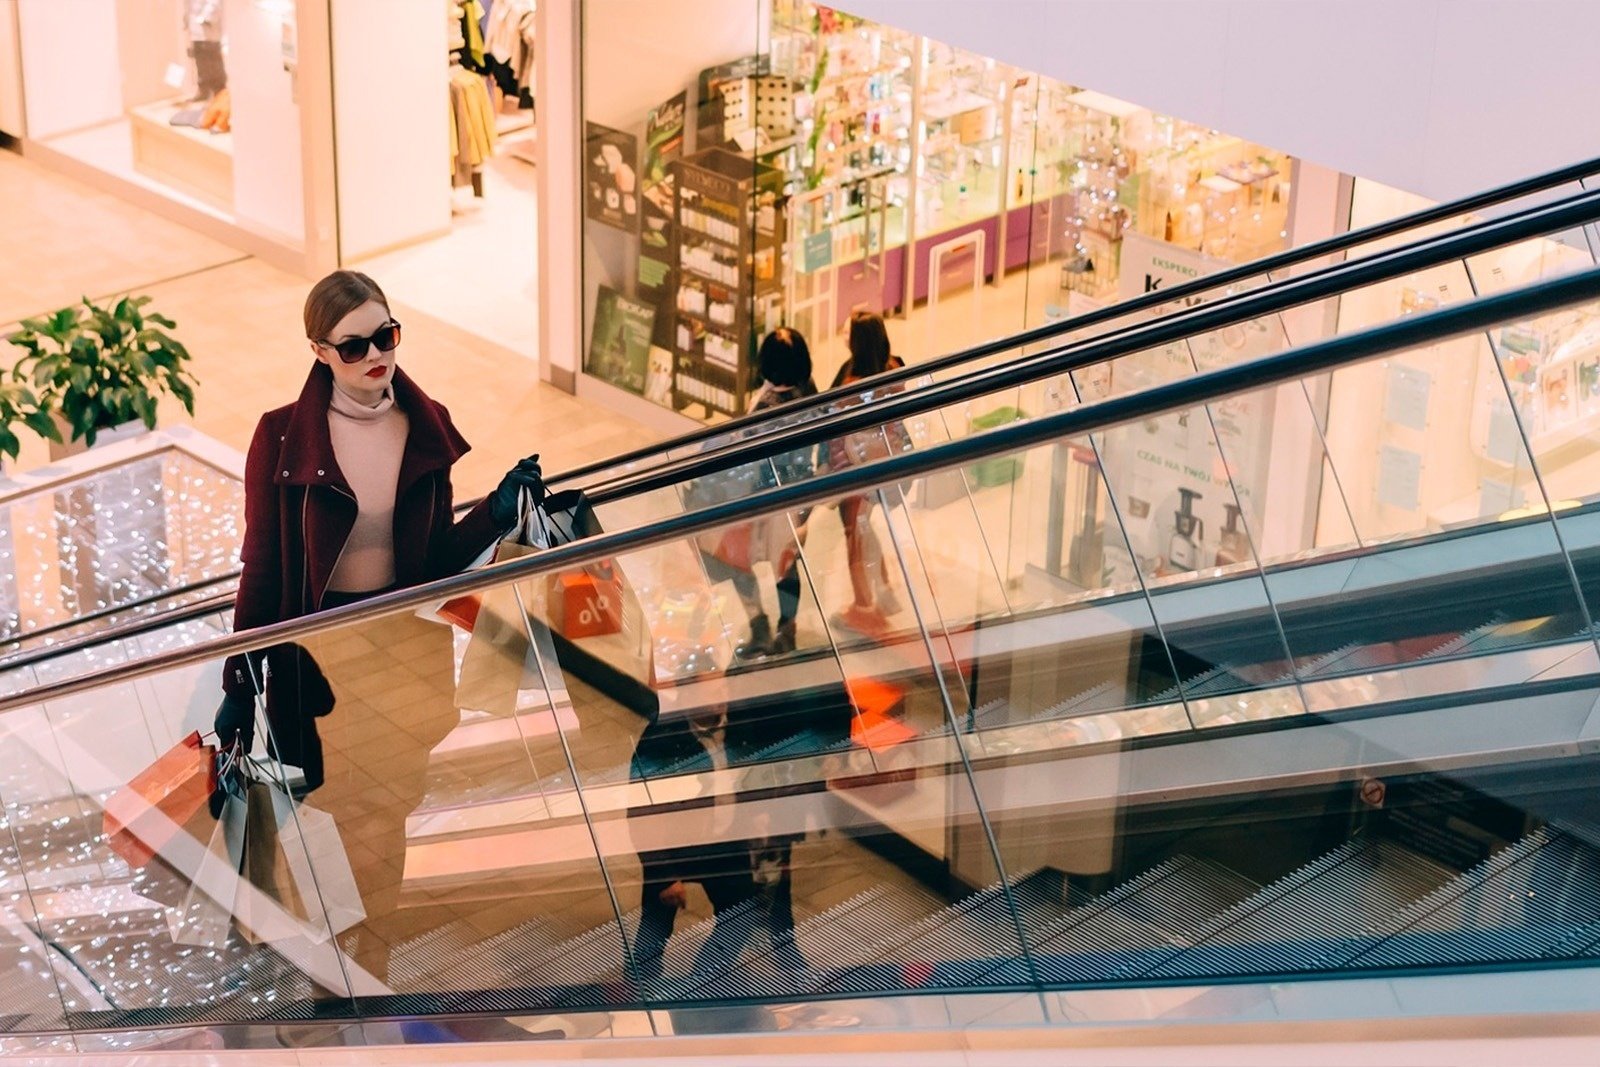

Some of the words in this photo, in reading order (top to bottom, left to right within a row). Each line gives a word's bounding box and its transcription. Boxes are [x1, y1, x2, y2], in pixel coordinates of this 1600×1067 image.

[1152, 256, 1199, 277] EKSPERCI
[1137, 450, 1162, 465] CZAS
[1164, 459, 1181, 471] NA
